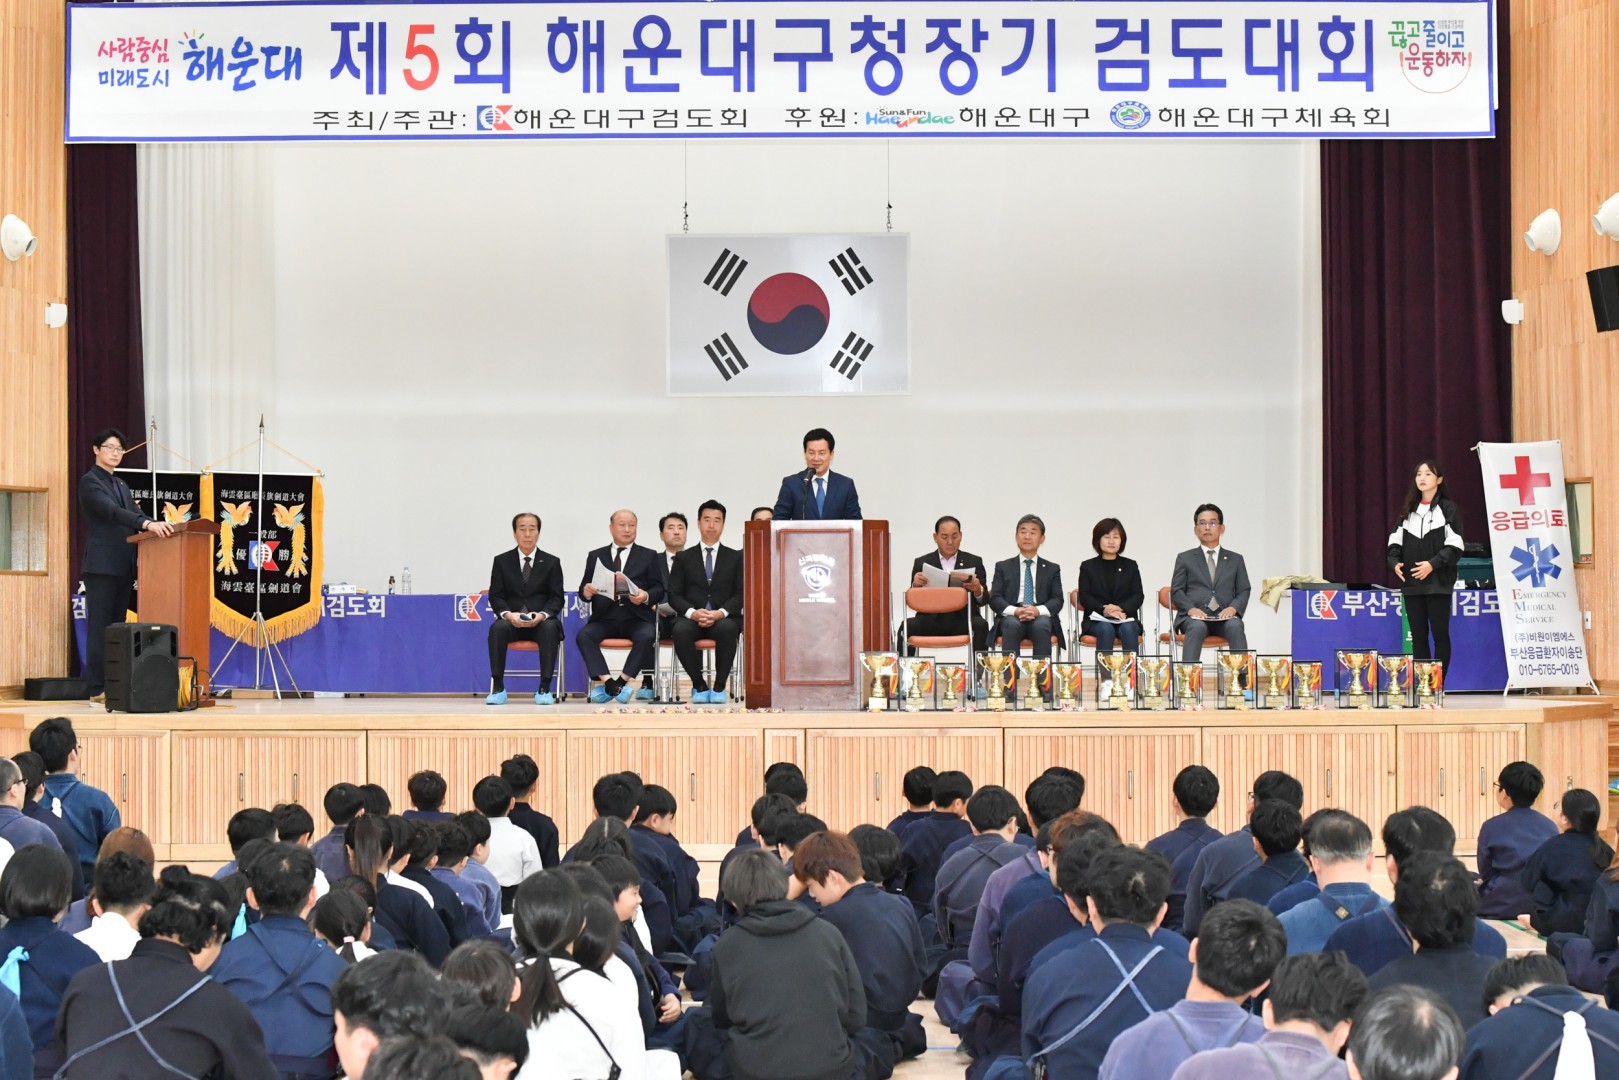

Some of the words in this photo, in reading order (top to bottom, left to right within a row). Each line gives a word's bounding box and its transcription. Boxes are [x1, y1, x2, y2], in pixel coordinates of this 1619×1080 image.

[1387, 21, 1420, 49] 끊고
[1422, 20, 1465, 48] 줄이고
[98, 36, 170, 63] 사람중심
[330, 16, 511, 95] 제5회
[546, 15, 1057, 96] 해운대구청장기
[1094, 15, 1374, 93] 검도대회
[182, 36, 303, 92] 해운대
[98, 67, 170, 88] 미래도시
[312, 110, 467, 131] 주최/주관:
[514, 108, 748, 129] 해운대구검도회
[784, 107, 859, 128] 후원:
[959, 106, 1091, 128] 해운대구
[1158, 107, 1390, 128] 해운대구체육회
[879, 108, 926, 116] Sun&Fun
[1491, 509, 1567, 532] 응급의료
[1510, 646, 1583, 660] 부산응급환자이송단
[1518, 663, 1580, 676] 010-6765-0019
